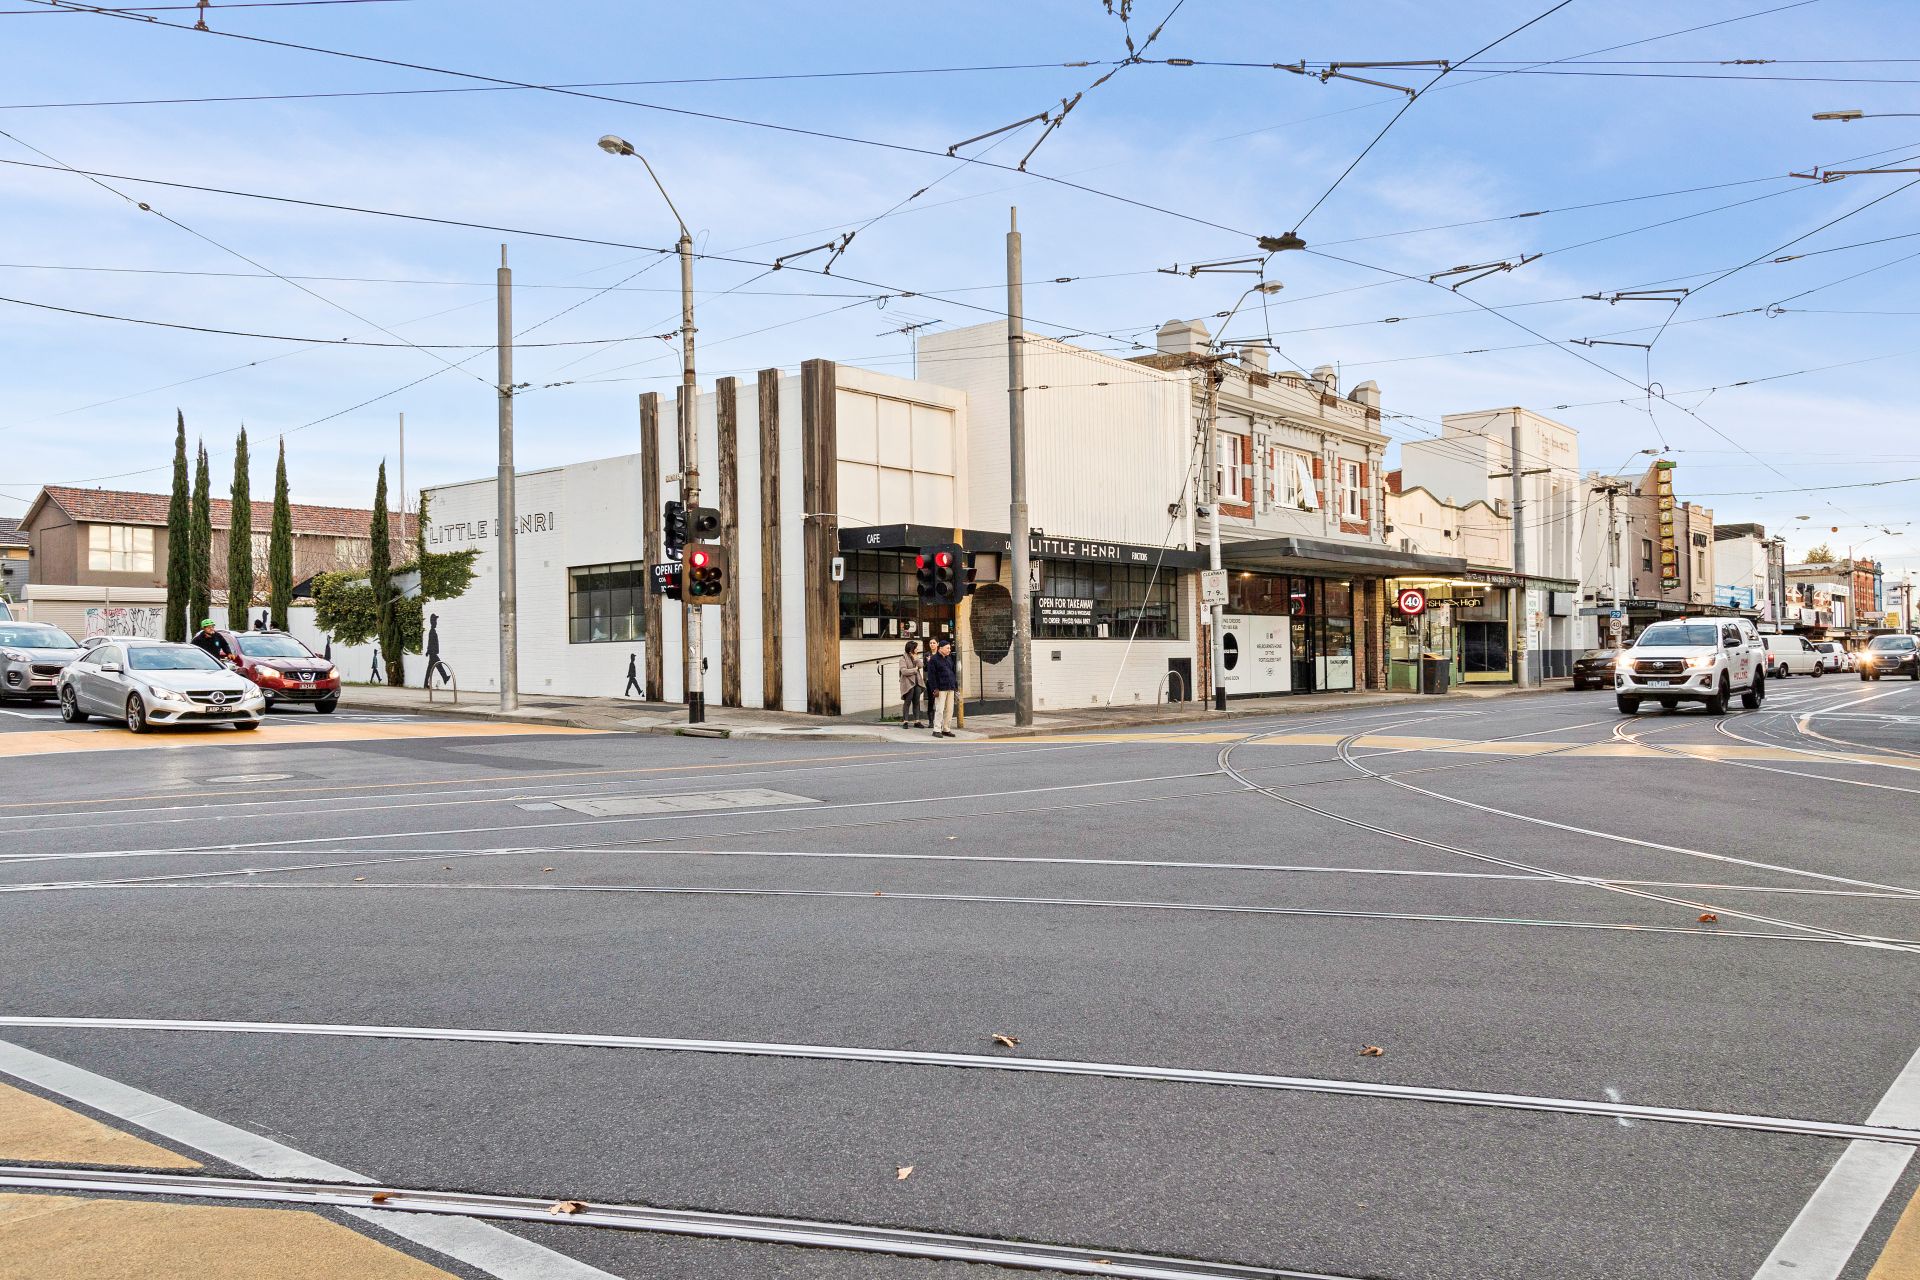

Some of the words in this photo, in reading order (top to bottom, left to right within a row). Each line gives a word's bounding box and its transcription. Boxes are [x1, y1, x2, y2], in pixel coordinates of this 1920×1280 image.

[429, 521, 487, 544] LITTLE
[495, 512, 553, 537] NRI
[866, 533, 880, 544] CAFE
[1030, 539, 1076, 555] LITTLE
[1081, 543, 1120, 559] HENRI
[655, 564, 672, 576] OPEN
[1039, 598, 1054, 608] OPEN
[1055, 598, 1067, 608] FOR
[1067, 599, 1094, 610] TAKEAWAY
[1405, 598, 1420, 607] 40
[1460, 598, 1481, 609] High
